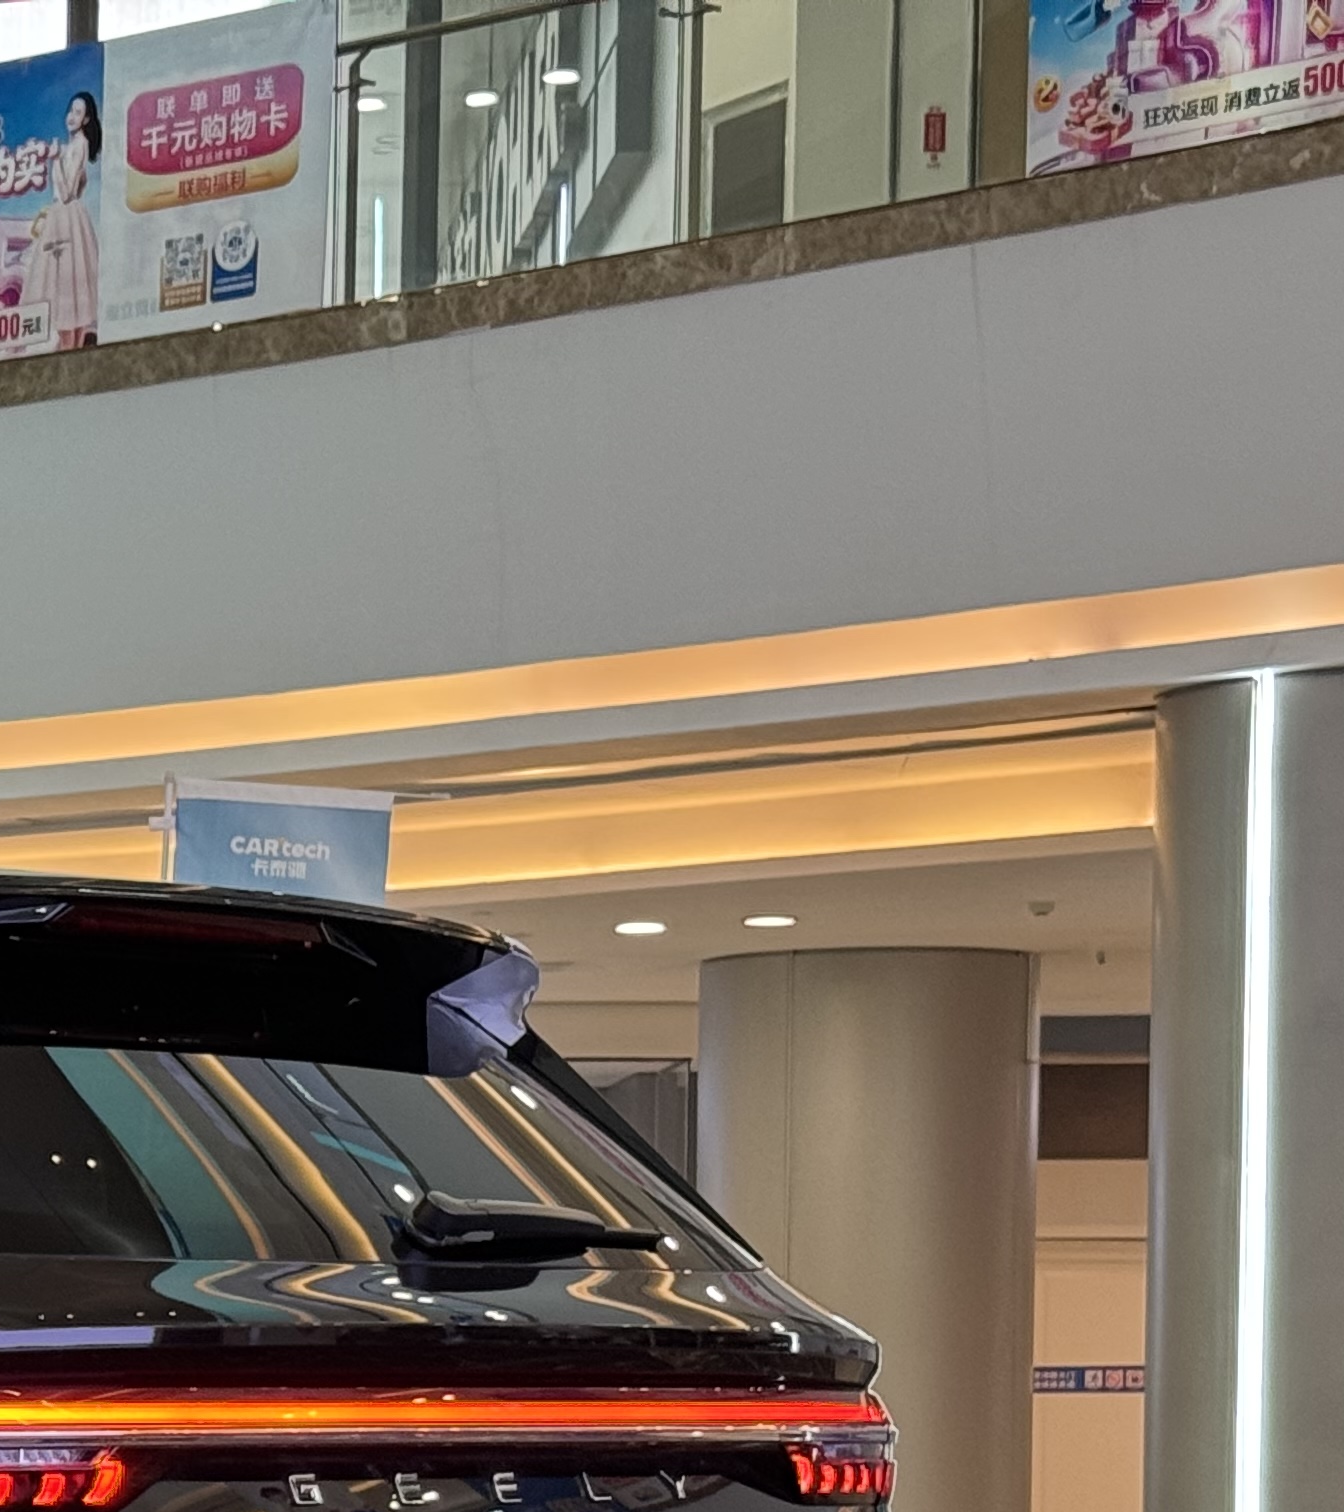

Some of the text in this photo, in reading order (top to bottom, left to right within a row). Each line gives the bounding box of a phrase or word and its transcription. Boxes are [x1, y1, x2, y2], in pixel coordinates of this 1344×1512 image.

[141, 101, 289, 160] 千元购物卡
[229, 835, 331, 861] CARtech
[288, 1470, 687, 1505] GEELY
